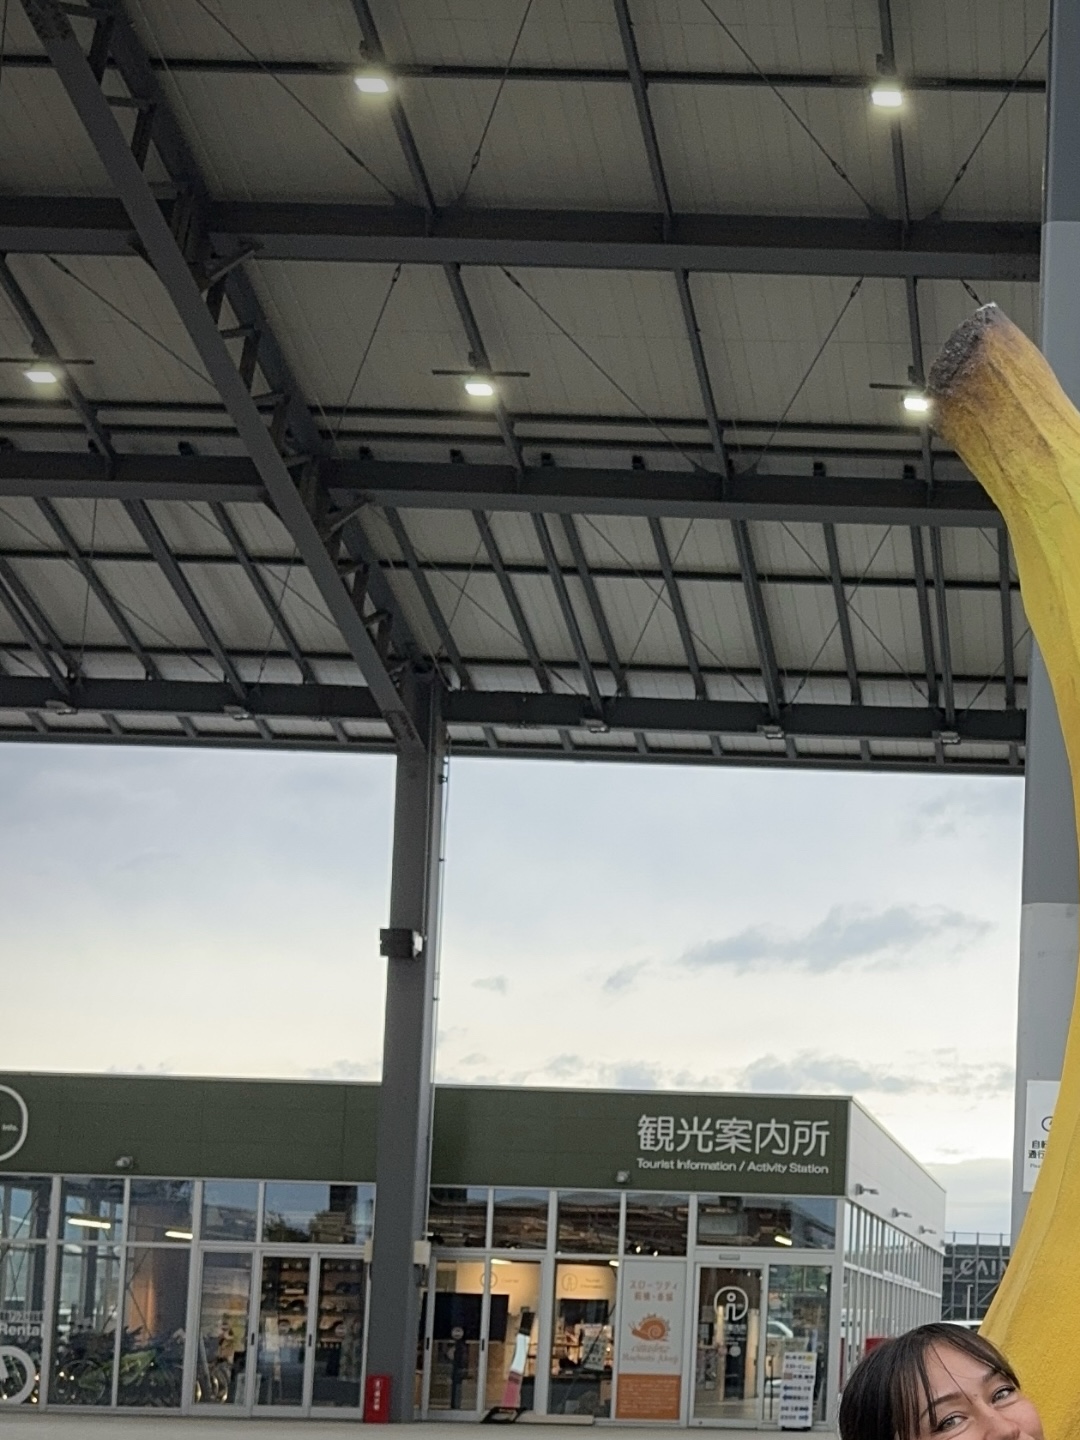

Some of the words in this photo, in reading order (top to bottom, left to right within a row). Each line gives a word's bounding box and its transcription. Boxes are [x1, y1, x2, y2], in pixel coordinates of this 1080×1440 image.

[637, 1114, 831, 1158] 観光案内所
[636, 1157, 675, 1170] Tourist
[676, 1159, 737, 1172] Information
[747, 1161, 787, 1174] Activity
[789, 1163, 830, 1175] Station
